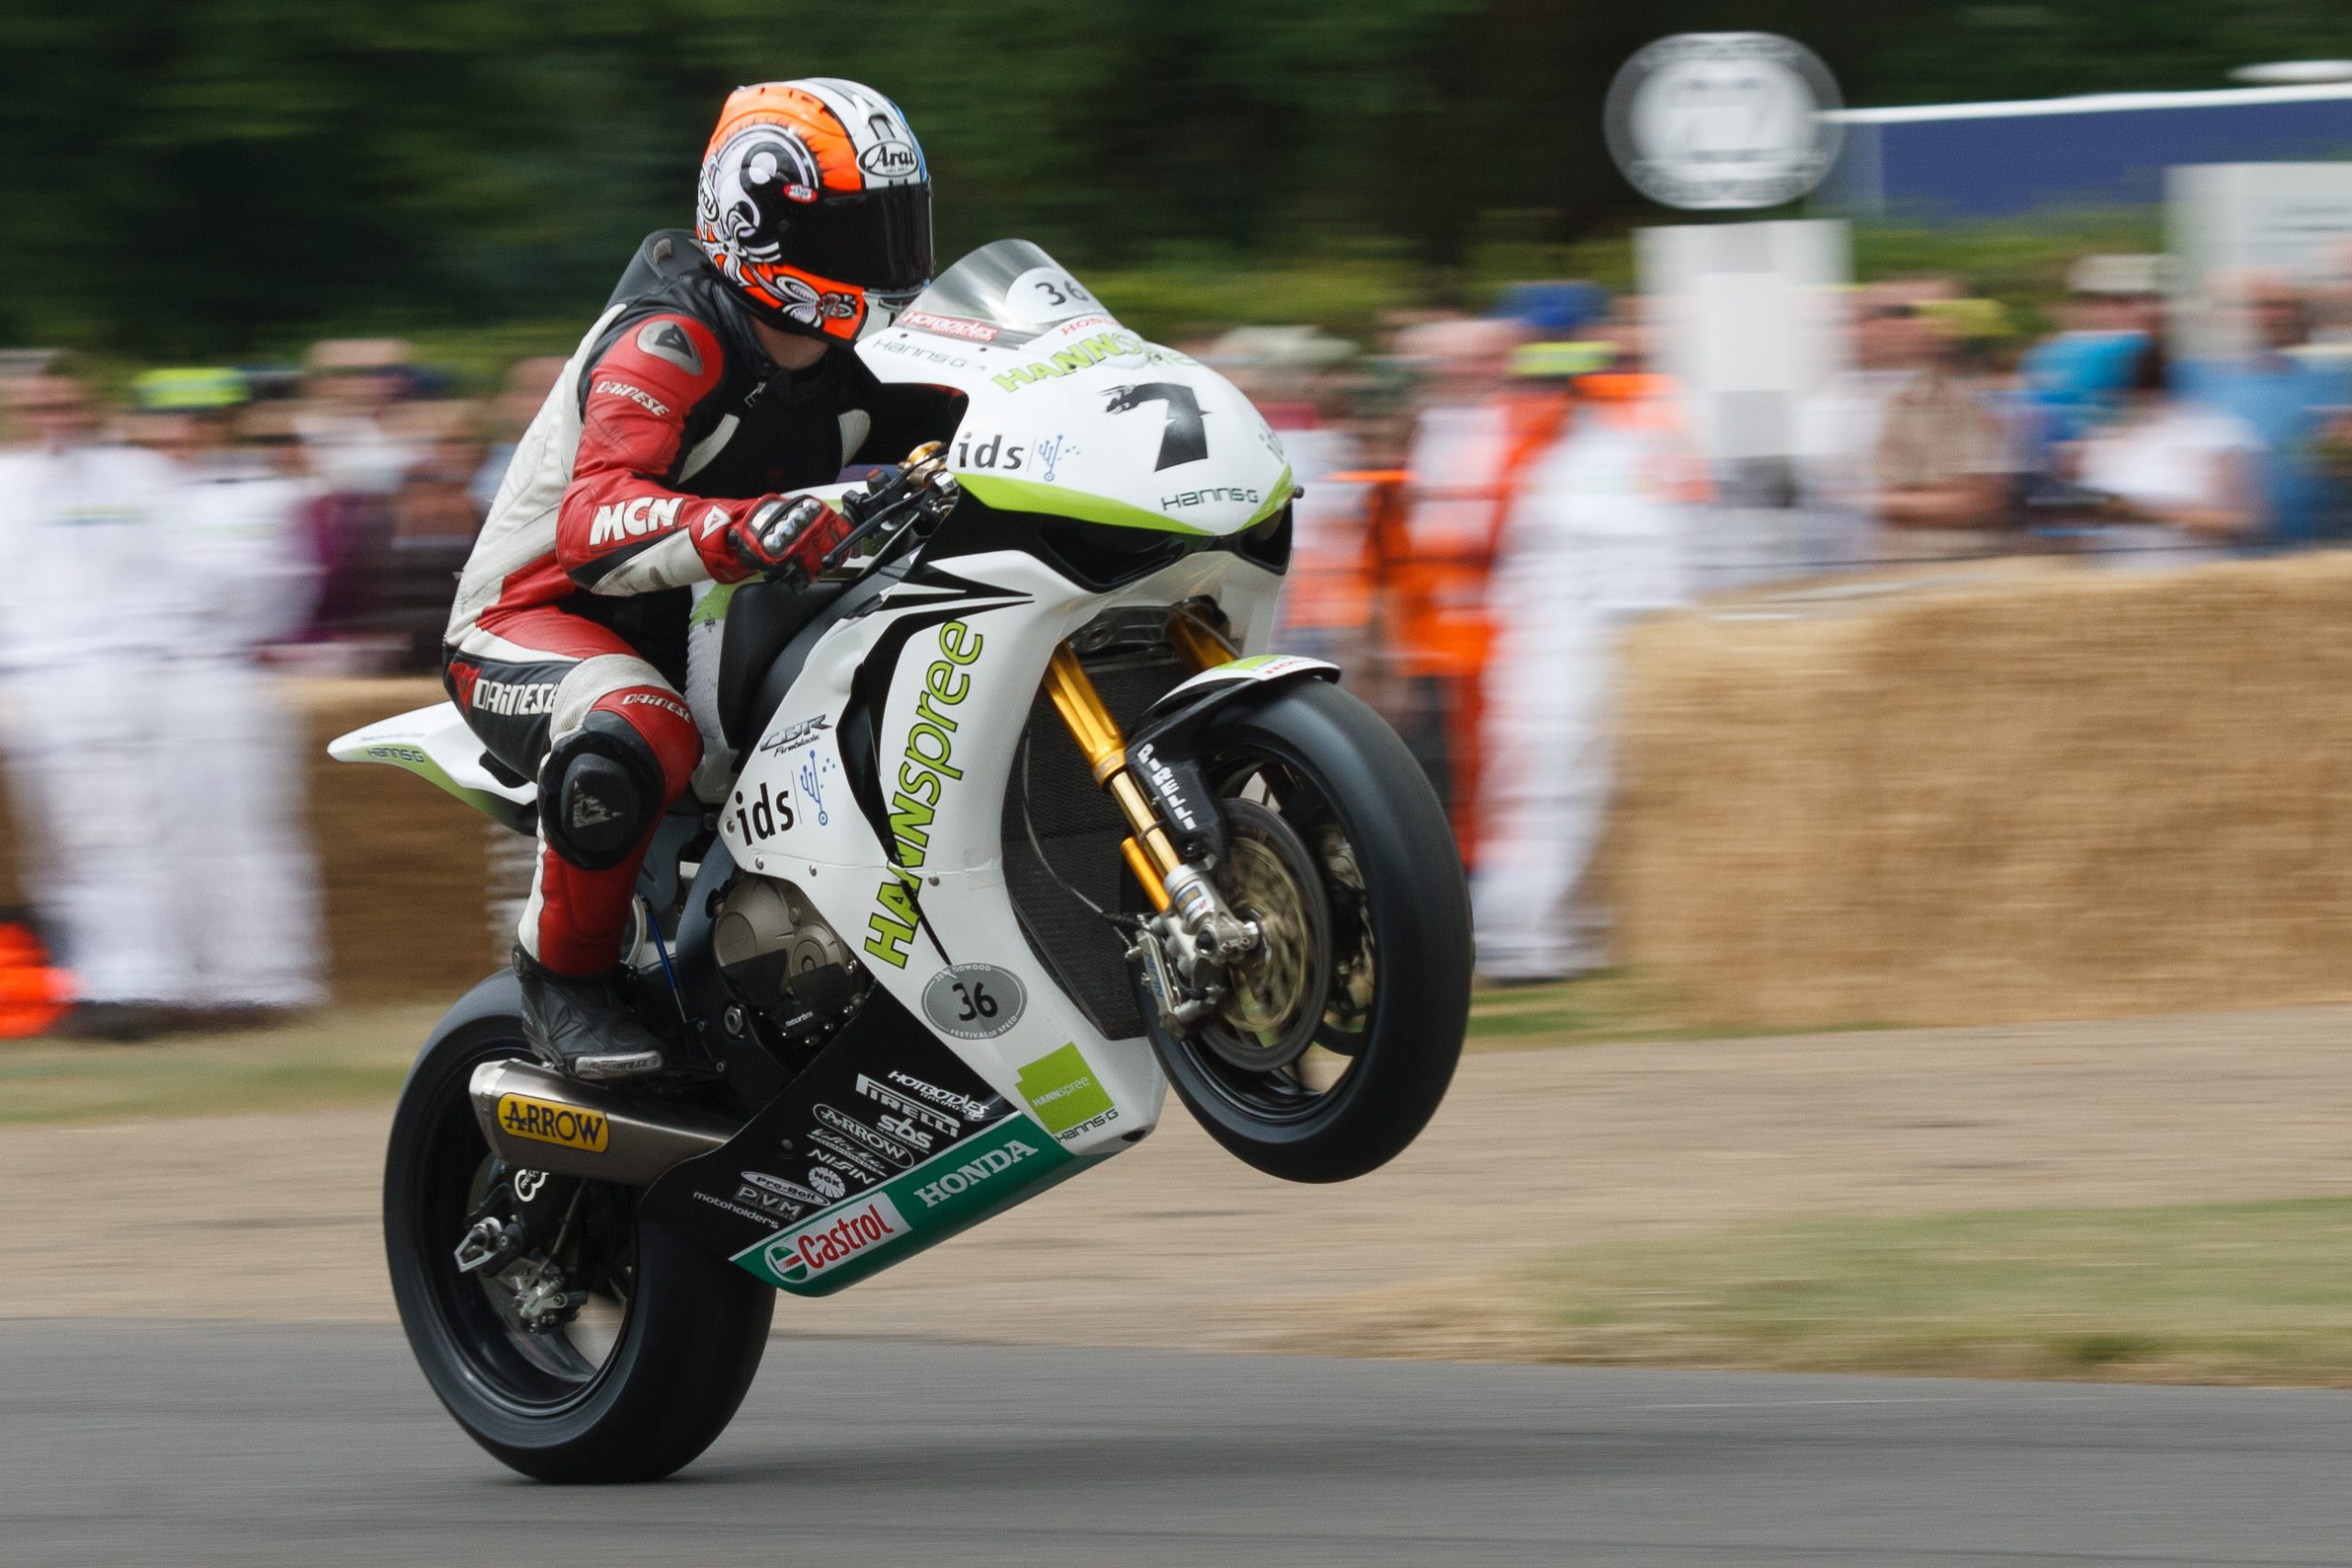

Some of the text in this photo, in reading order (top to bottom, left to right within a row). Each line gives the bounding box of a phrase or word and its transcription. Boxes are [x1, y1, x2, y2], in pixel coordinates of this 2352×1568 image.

[866, 145, 915, 169] Arai
[1035, 282, 1090, 306] 36
[1061, 315, 1118, 336] HON
[1101, 381, 1211, 472] 7
[958, 432, 1025, 469] ids
[589, 497, 684, 546] MCN
[1137, 743, 1197, 830] PIRELLI
[735, 783, 794, 846] ids
[952, 981, 998, 1021] 36
[950, 1028, 989, 1039] FESTIVAL
[503, 1101, 603, 1145] ARROW
[855, 1073, 961, 1138] PIRELLI
[820, 1110, 906, 1159] ARROW
[814, 1171, 840, 1189] NGK
[913, 1139, 1039, 1208] HONDA
[693, 1191, 780, 1230] motoholders
[738, 1187, 800, 1216] PVM
[797, 1204, 894, 1269] Castrol
